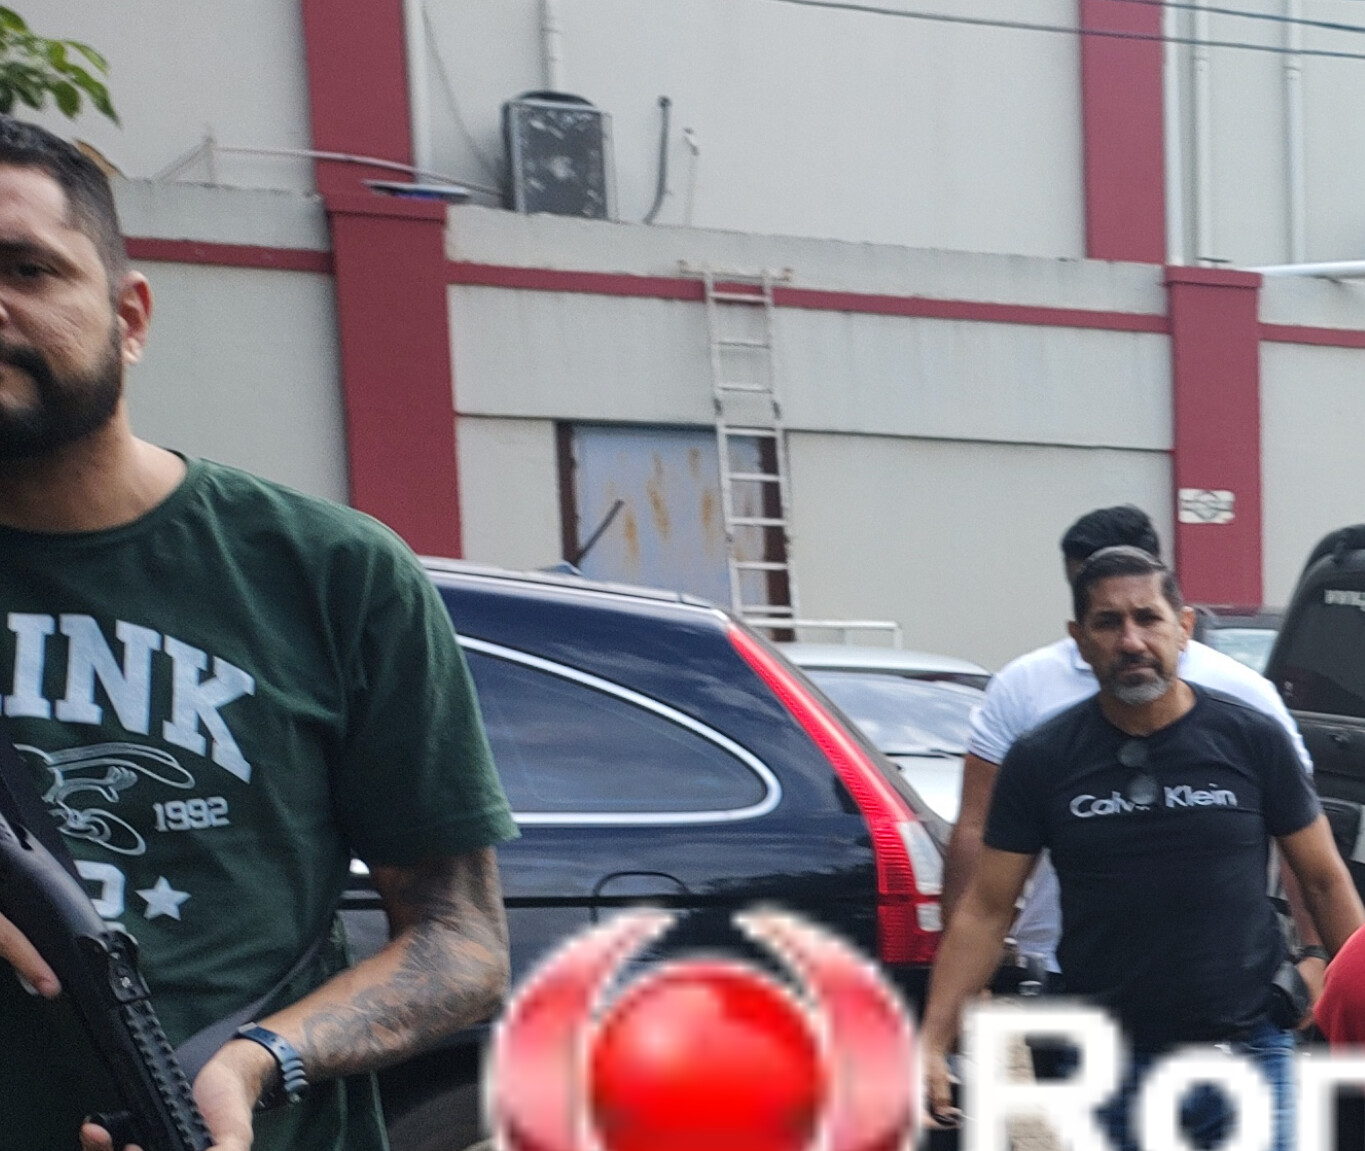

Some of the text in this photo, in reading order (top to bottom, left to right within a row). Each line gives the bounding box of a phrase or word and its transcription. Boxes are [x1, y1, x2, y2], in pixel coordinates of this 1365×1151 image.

[0, 611, 255, 785] INK
[1163, 782, 1238, 808] Klein
[153, 796, 231, 832] 1992
